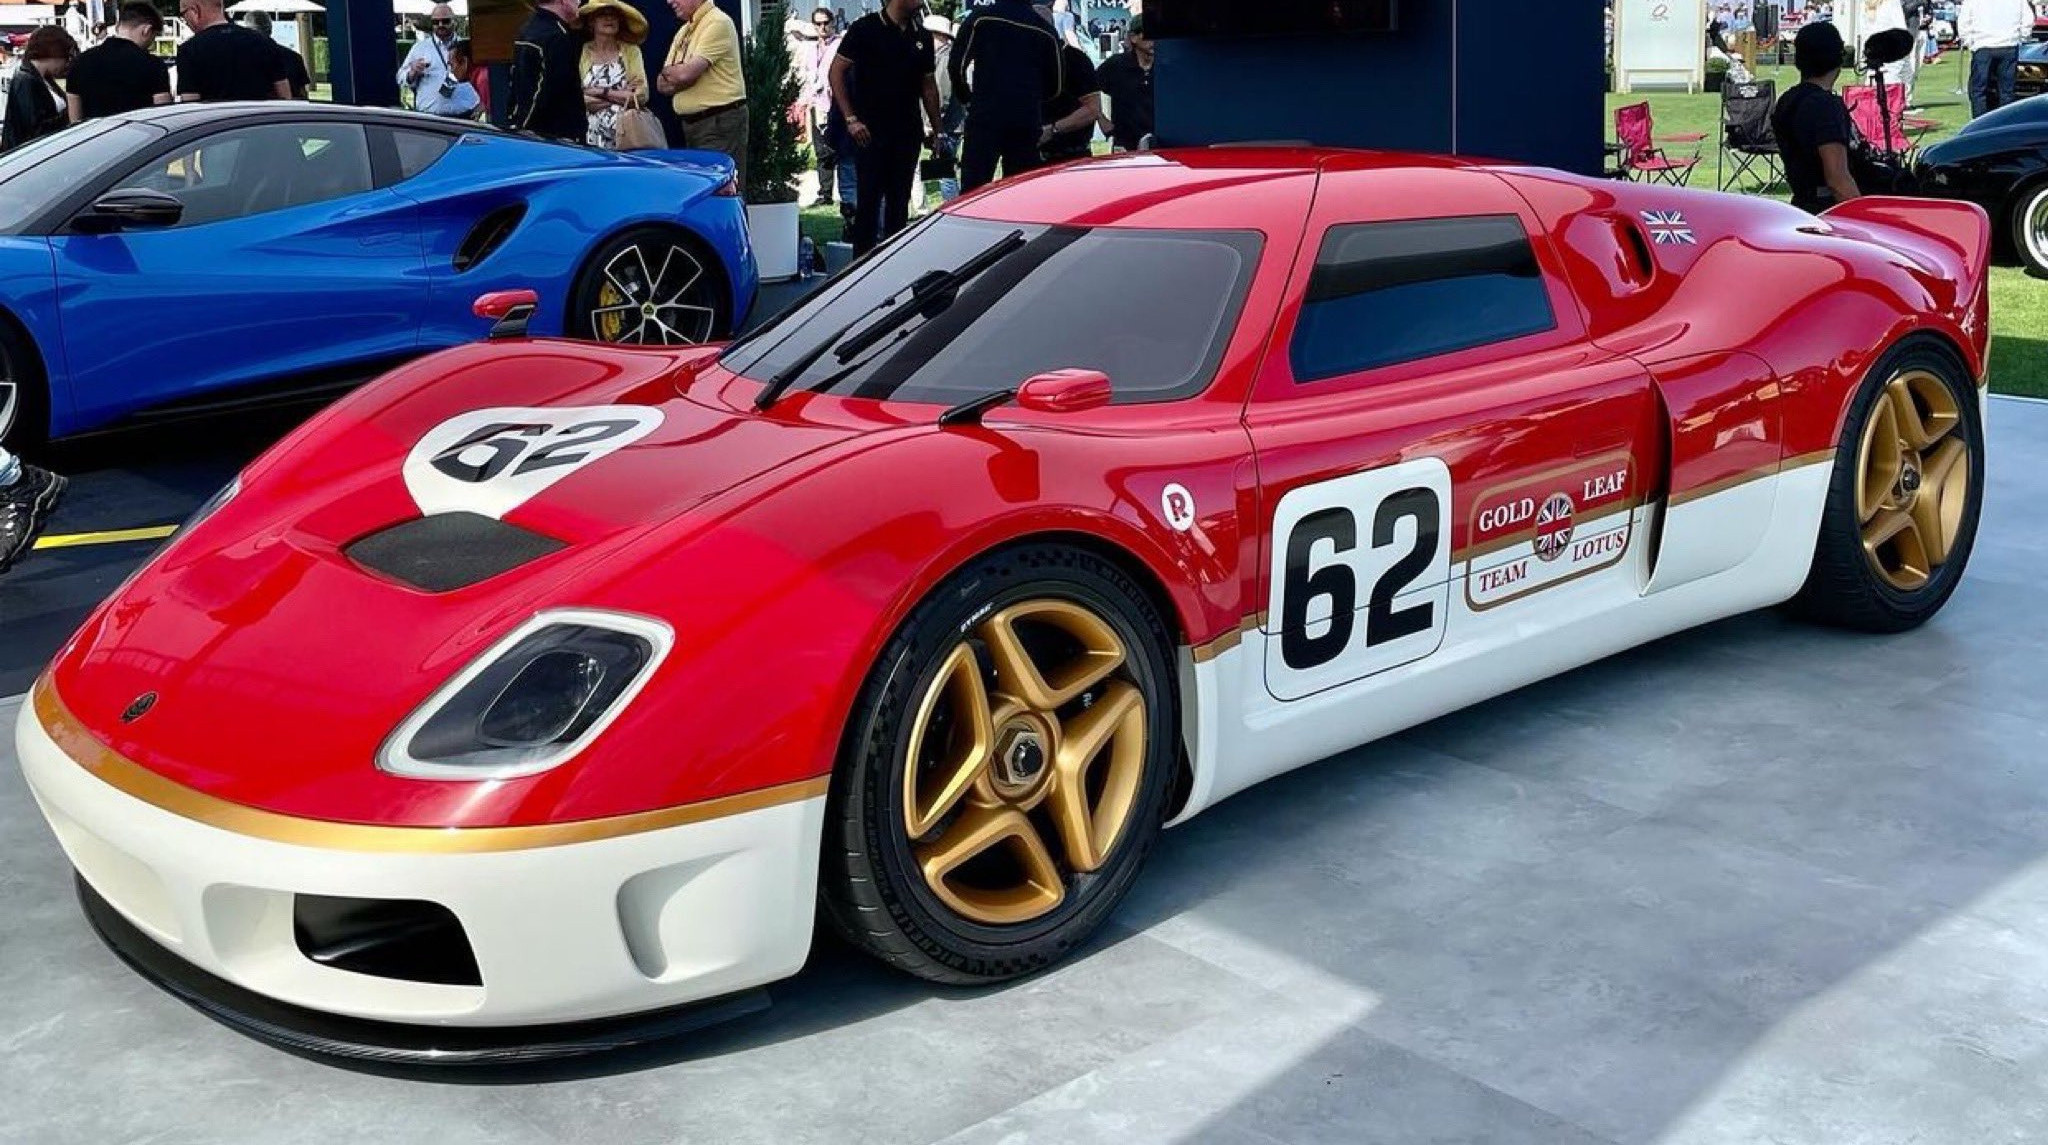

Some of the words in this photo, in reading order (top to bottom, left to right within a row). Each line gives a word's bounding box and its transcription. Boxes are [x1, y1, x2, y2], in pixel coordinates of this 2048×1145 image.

[429, 419, 641, 484] 62
[1166, 492, 1190, 522] R
[1479, 497, 1535, 532] GOLD
[1583, 470, 1627, 501] LEAF
[1282, 486, 1440, 671] 62
[1480, 560, 1528, 593] TEAM
[1573, 530, 1625, 562] LOTUS
